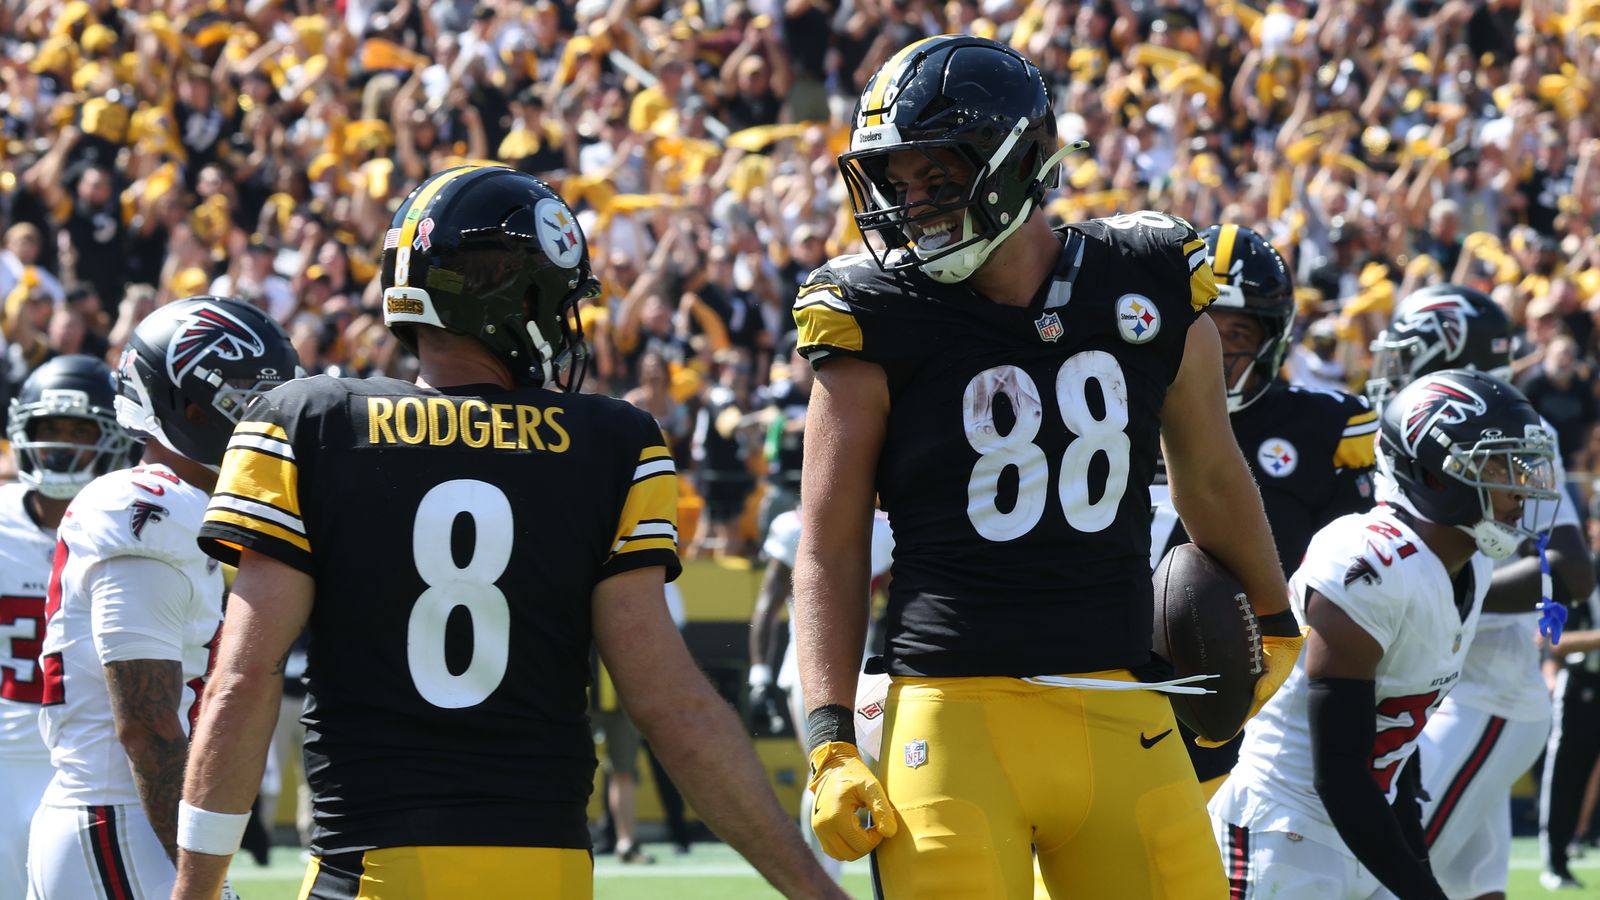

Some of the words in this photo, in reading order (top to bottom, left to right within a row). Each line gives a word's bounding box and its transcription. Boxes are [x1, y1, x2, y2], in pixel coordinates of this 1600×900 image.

[859, 131, 882, 143] Steelers
[395, 246, 411, 286] 8
[386, 293, 425, 315] Steelers
[1121, 313, 1138, 321] Steelers
[1041, 323, 1061, 338] NFL
[367, 397, 570, 453] RODGERS
[963, 350, 1131, 541] 88
[407, 479, 514, 708] 8
